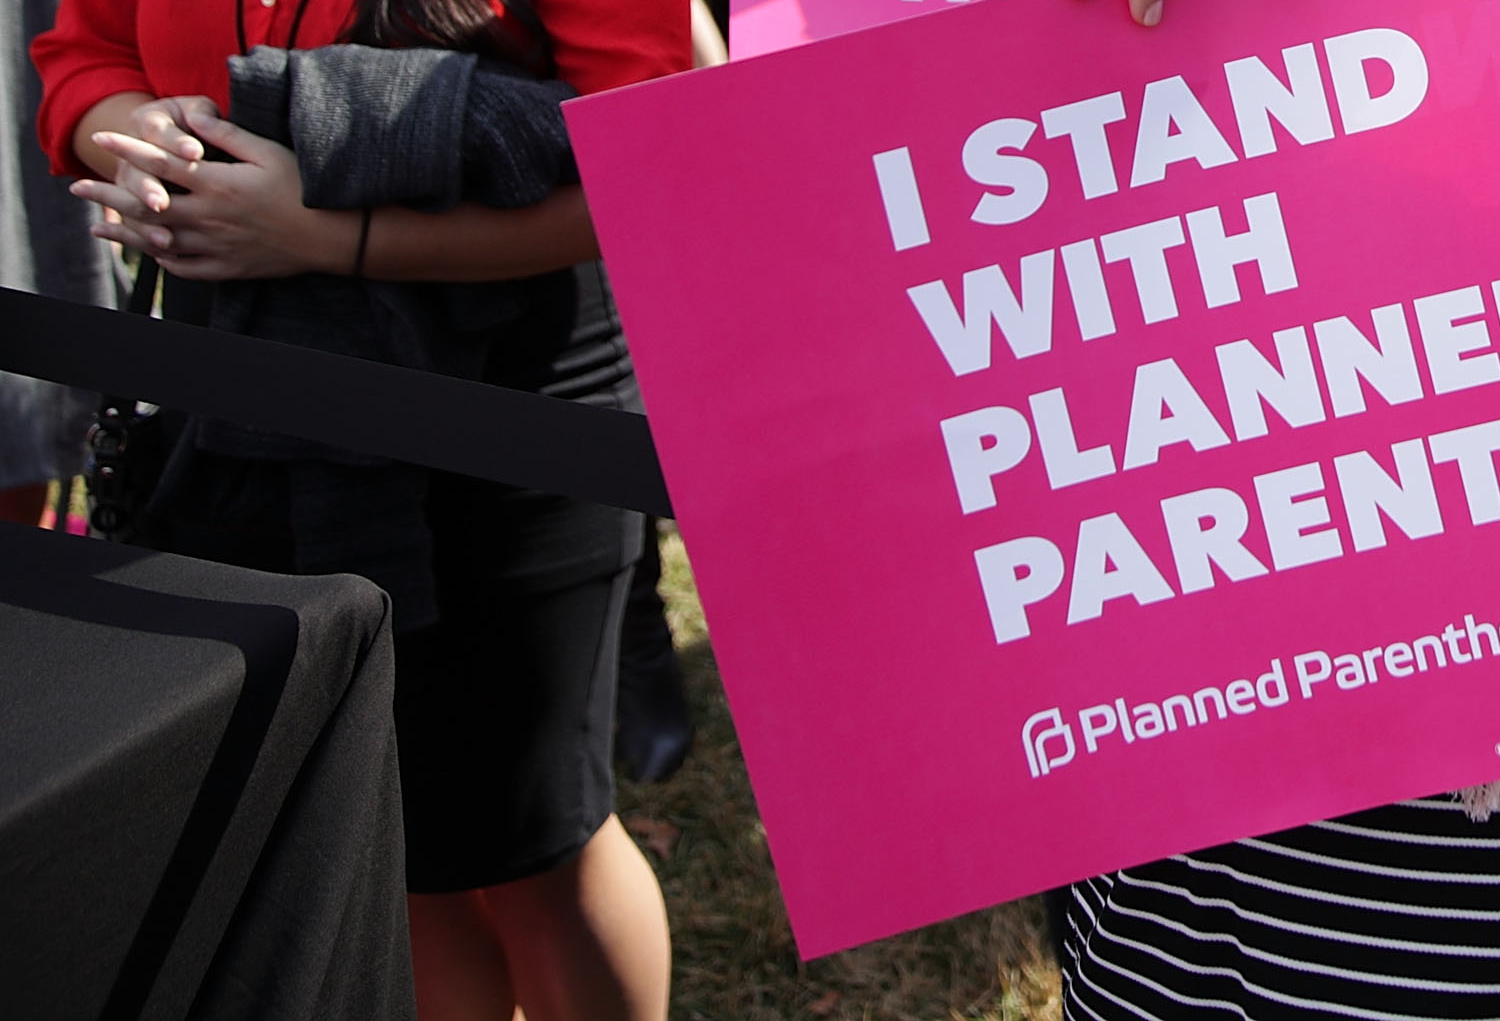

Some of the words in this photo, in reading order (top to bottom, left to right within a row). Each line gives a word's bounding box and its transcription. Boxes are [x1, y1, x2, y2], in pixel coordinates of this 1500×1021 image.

[873, 147, 931, 251] I
[962, 28, 1429, 225] STAND
[906, 192, 1299, 377] WITH
[1078, 658, 1290, 754] Planned
